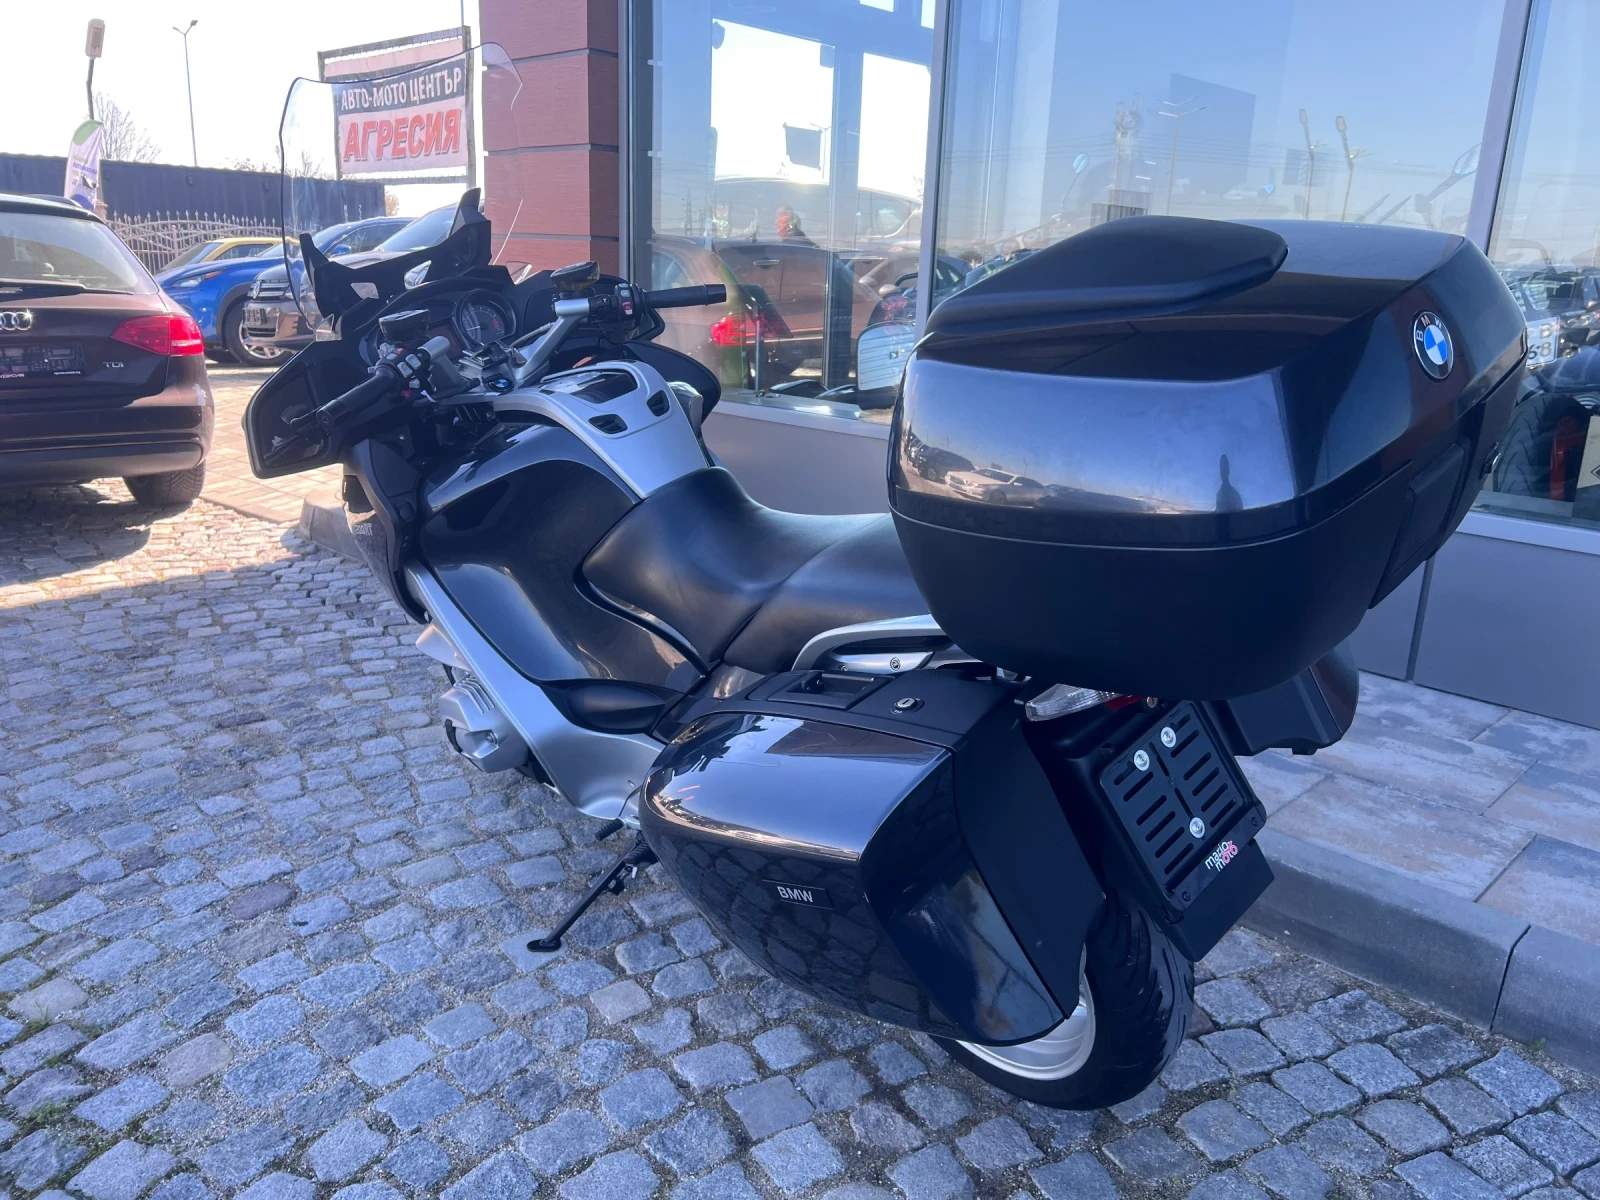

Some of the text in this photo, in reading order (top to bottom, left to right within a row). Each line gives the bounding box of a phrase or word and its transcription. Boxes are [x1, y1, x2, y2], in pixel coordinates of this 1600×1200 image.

[409, 67, 462, 104] ЦЕНТЪР
[343, 108, 463, 162] АГРЕСИЯ
[1415, 314, 1442, 342] BMW
[1204, 841, 1229, 870] mario
[776, 885, 814, 903] BMW
